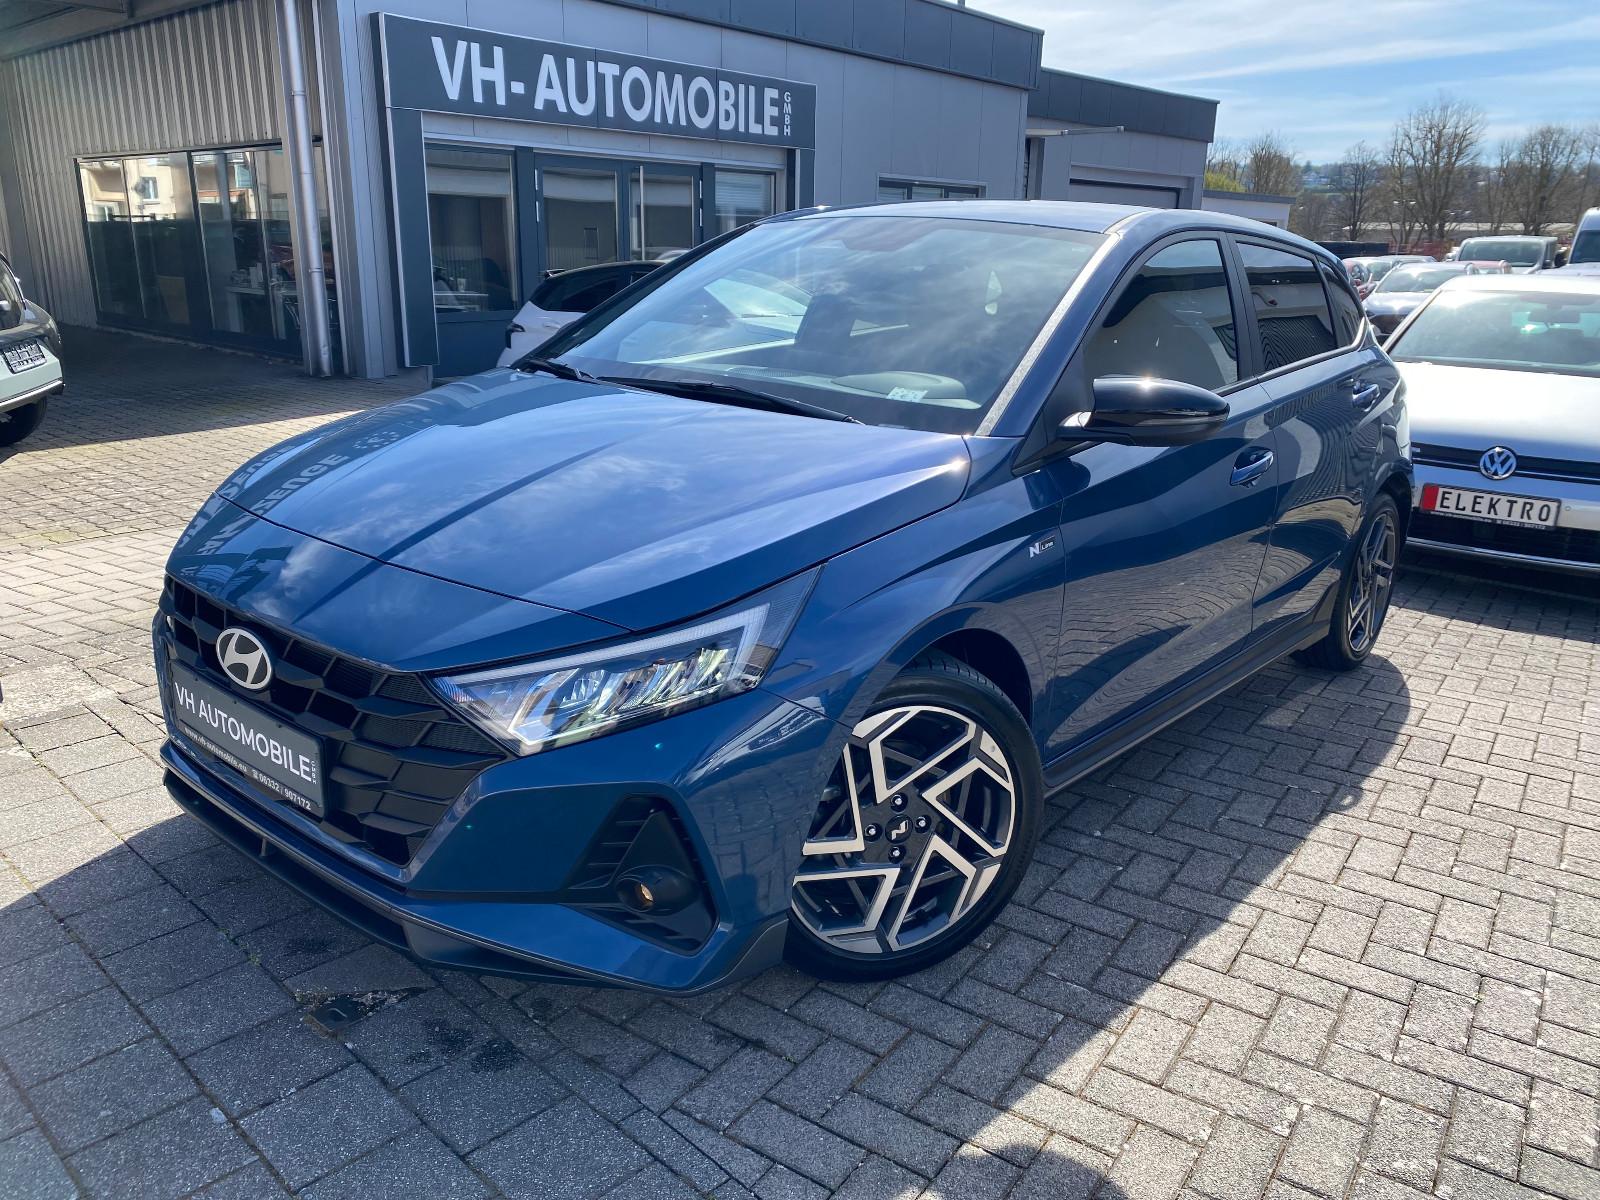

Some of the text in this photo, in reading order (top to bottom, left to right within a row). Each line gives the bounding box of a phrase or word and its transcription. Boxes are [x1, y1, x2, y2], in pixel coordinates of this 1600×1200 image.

[533, 53, 780, 136] AUTOMOBILE
[783, 91, 792, 136] GMBH
[1440, 491, 1551, 522] ELEKTRO
[175, 682, 312, 782] VH AUTOMOBILE
[284, 788, 312, 810] 907172
